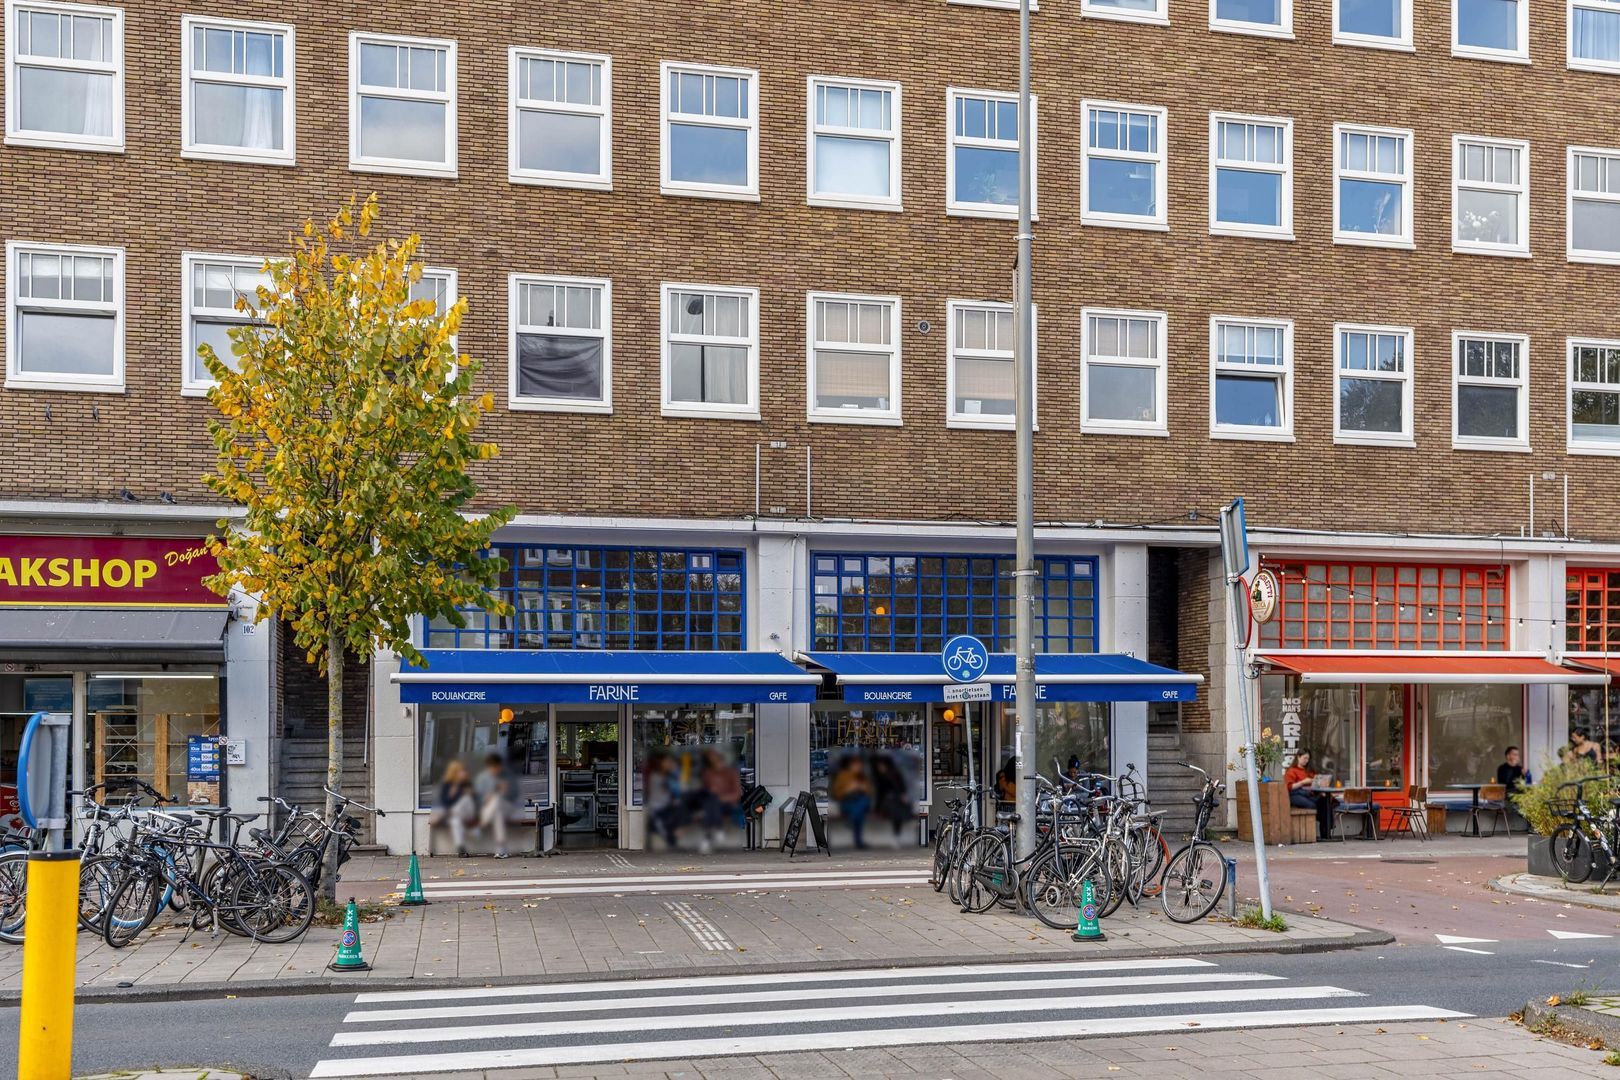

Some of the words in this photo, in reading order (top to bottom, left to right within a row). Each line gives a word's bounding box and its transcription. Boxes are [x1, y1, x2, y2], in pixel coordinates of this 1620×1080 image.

[164, 547, 208, 567] Doğan
[243, 625, 255, 634] 102
[431, 691, 486, 701] BOULANGERIE
[589, 685, 640, 701] FARINE
[769, 692, 787, 700] CAFE
[864, 691, 912, 700] BOULANGERIE
[1162, 690, 1178, 699] CAFE
[838, 718, 899, 737] FARINE
